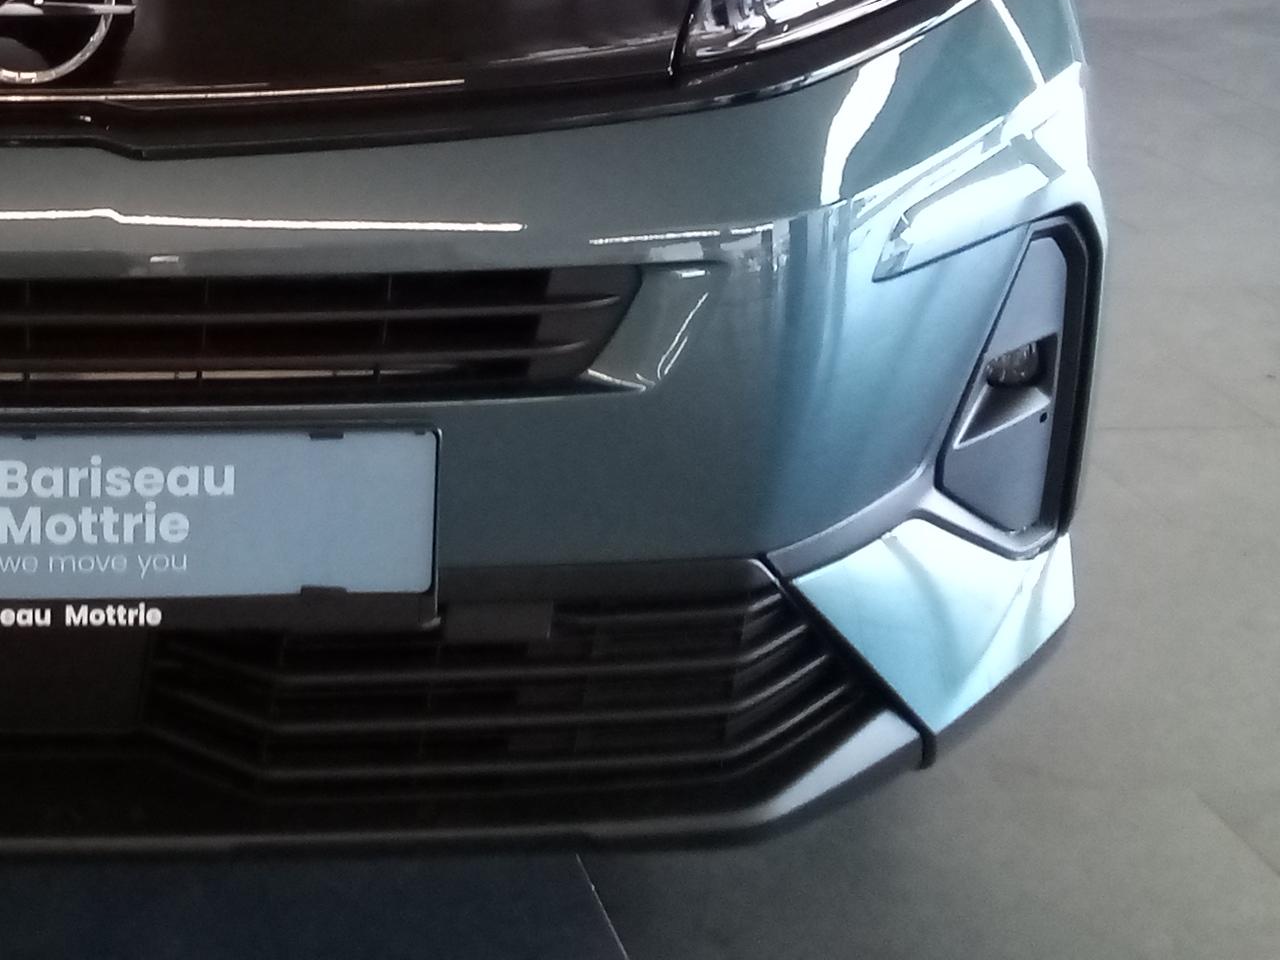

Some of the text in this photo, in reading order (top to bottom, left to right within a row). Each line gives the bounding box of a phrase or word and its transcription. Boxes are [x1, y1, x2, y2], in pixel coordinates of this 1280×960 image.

[48, 553, 128, 573] move
[137, 553, 189, 578] you
[65, 602, 163, 627] Mottrie
